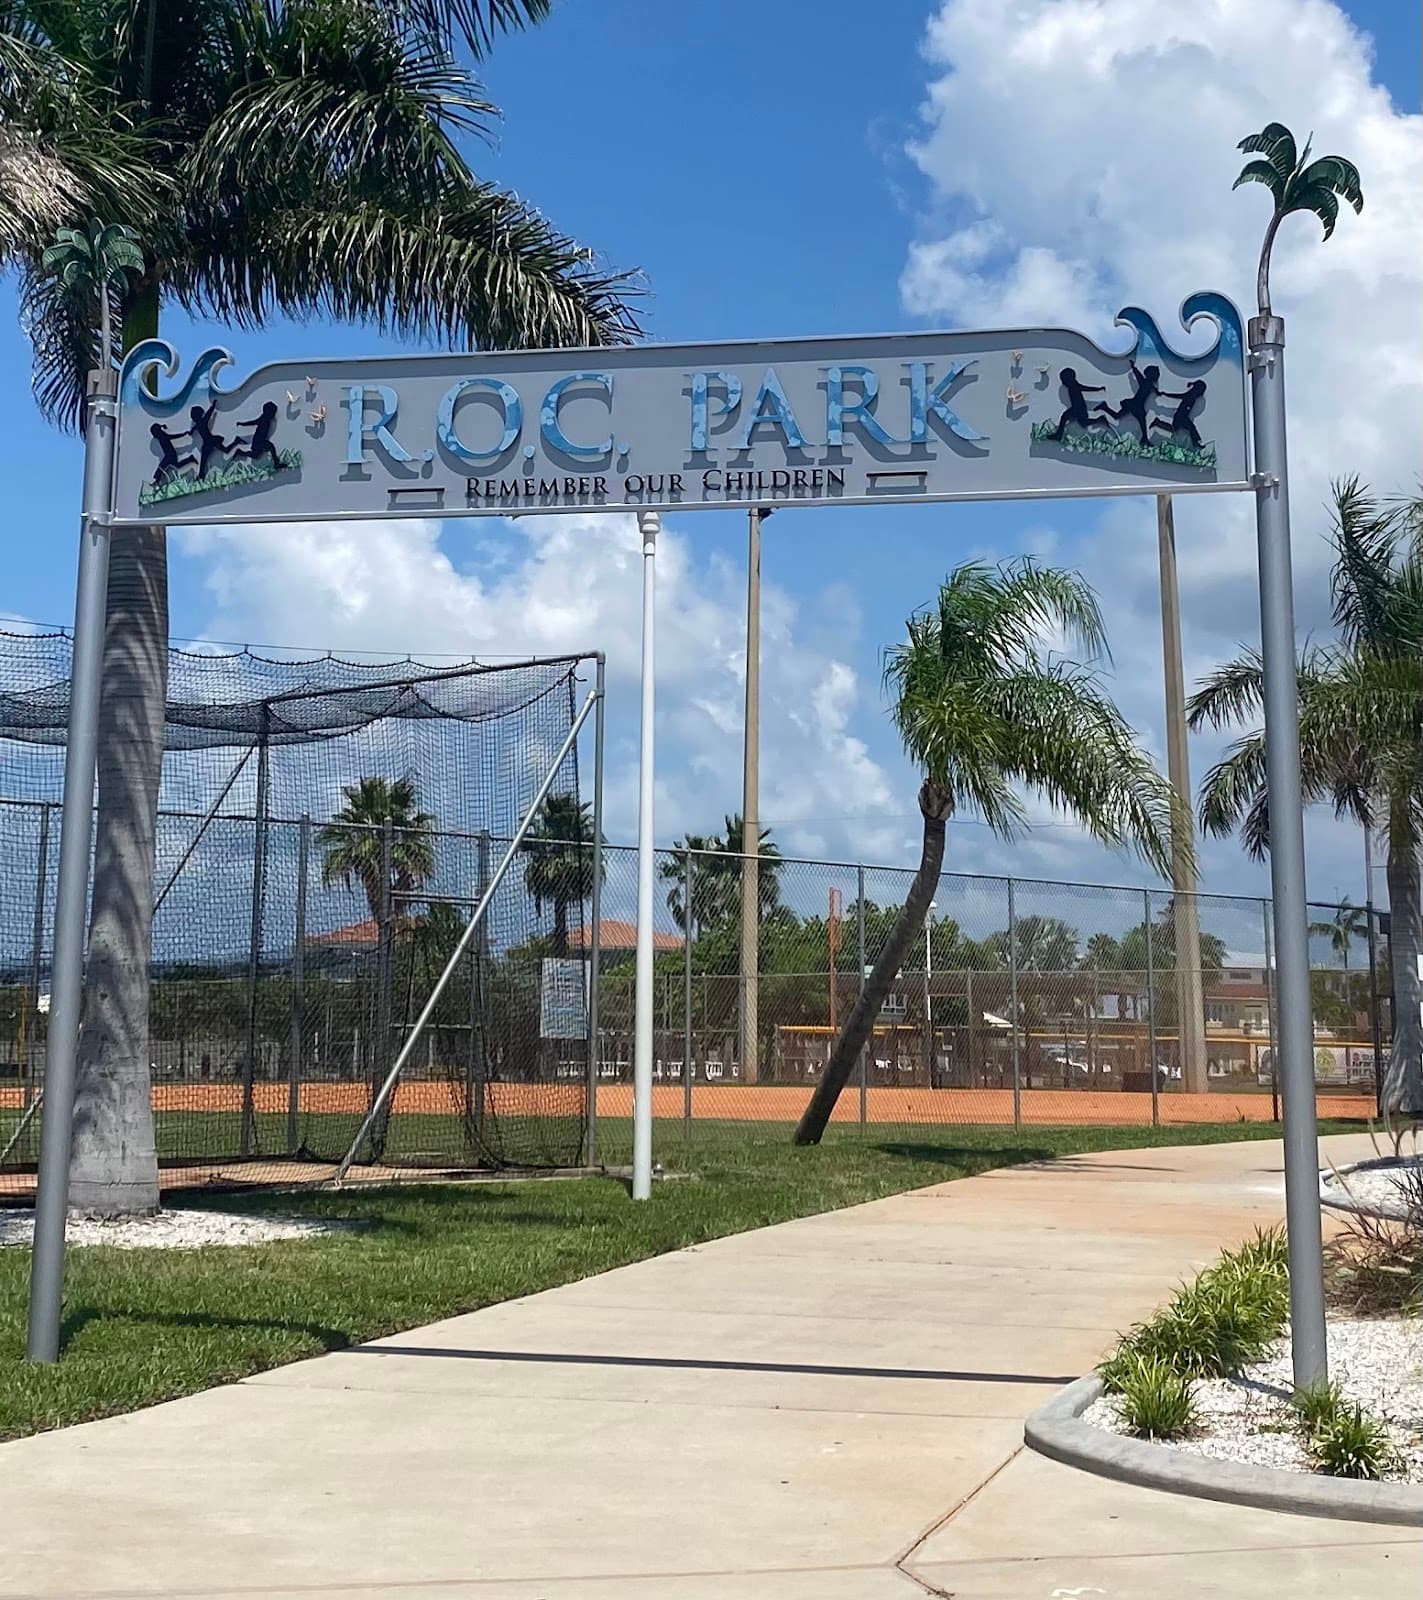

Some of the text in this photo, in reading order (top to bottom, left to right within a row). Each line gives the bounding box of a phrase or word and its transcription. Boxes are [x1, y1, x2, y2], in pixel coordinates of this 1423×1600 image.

[339, 360, 990, 464] R.O.C. PARK
[466, 467, 845, 497] REMEMBER OUR CHILDREN
